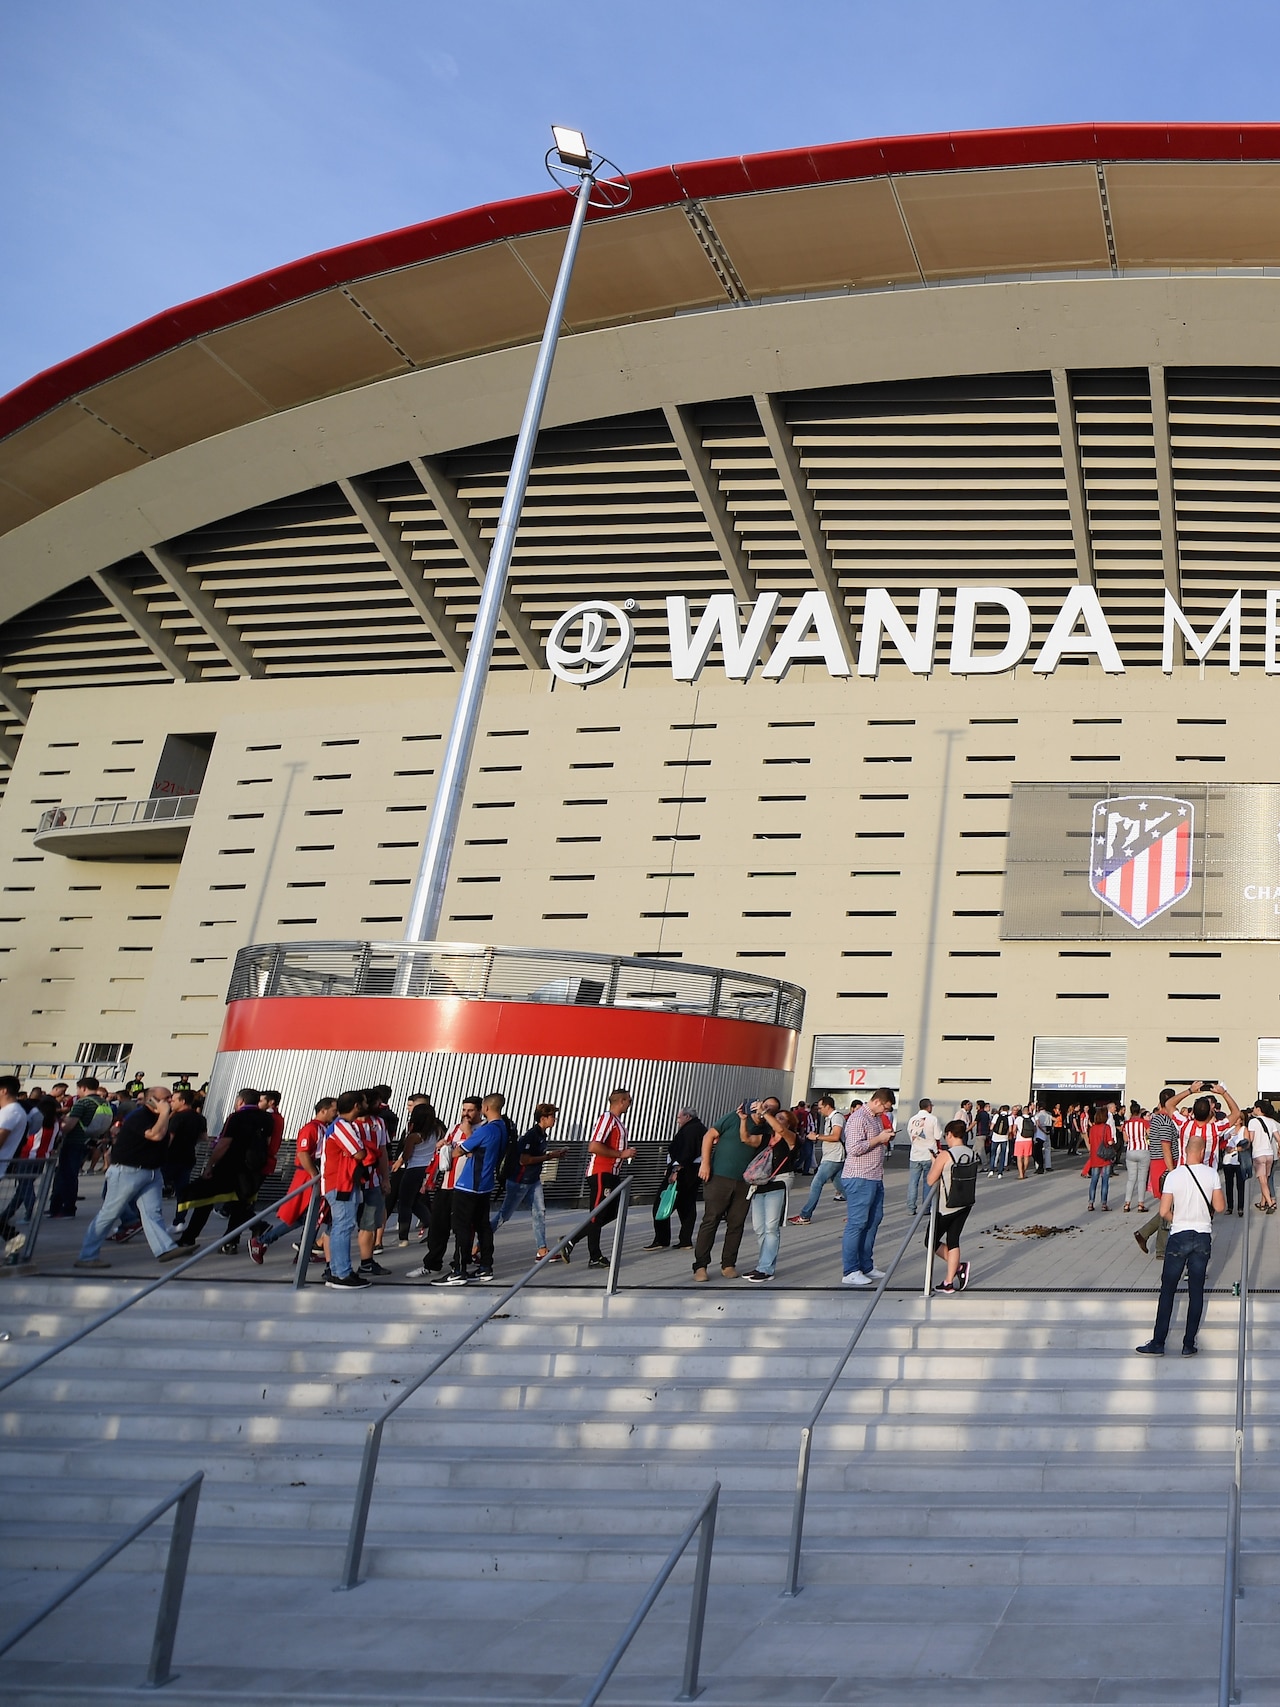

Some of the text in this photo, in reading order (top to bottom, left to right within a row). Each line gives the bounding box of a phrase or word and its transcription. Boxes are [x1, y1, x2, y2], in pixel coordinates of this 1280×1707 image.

[667, 585, 1127, 682] WANDA
[848, 1068, 867, 1086] 12
[1072, 1071, 1086, 1084] 11
